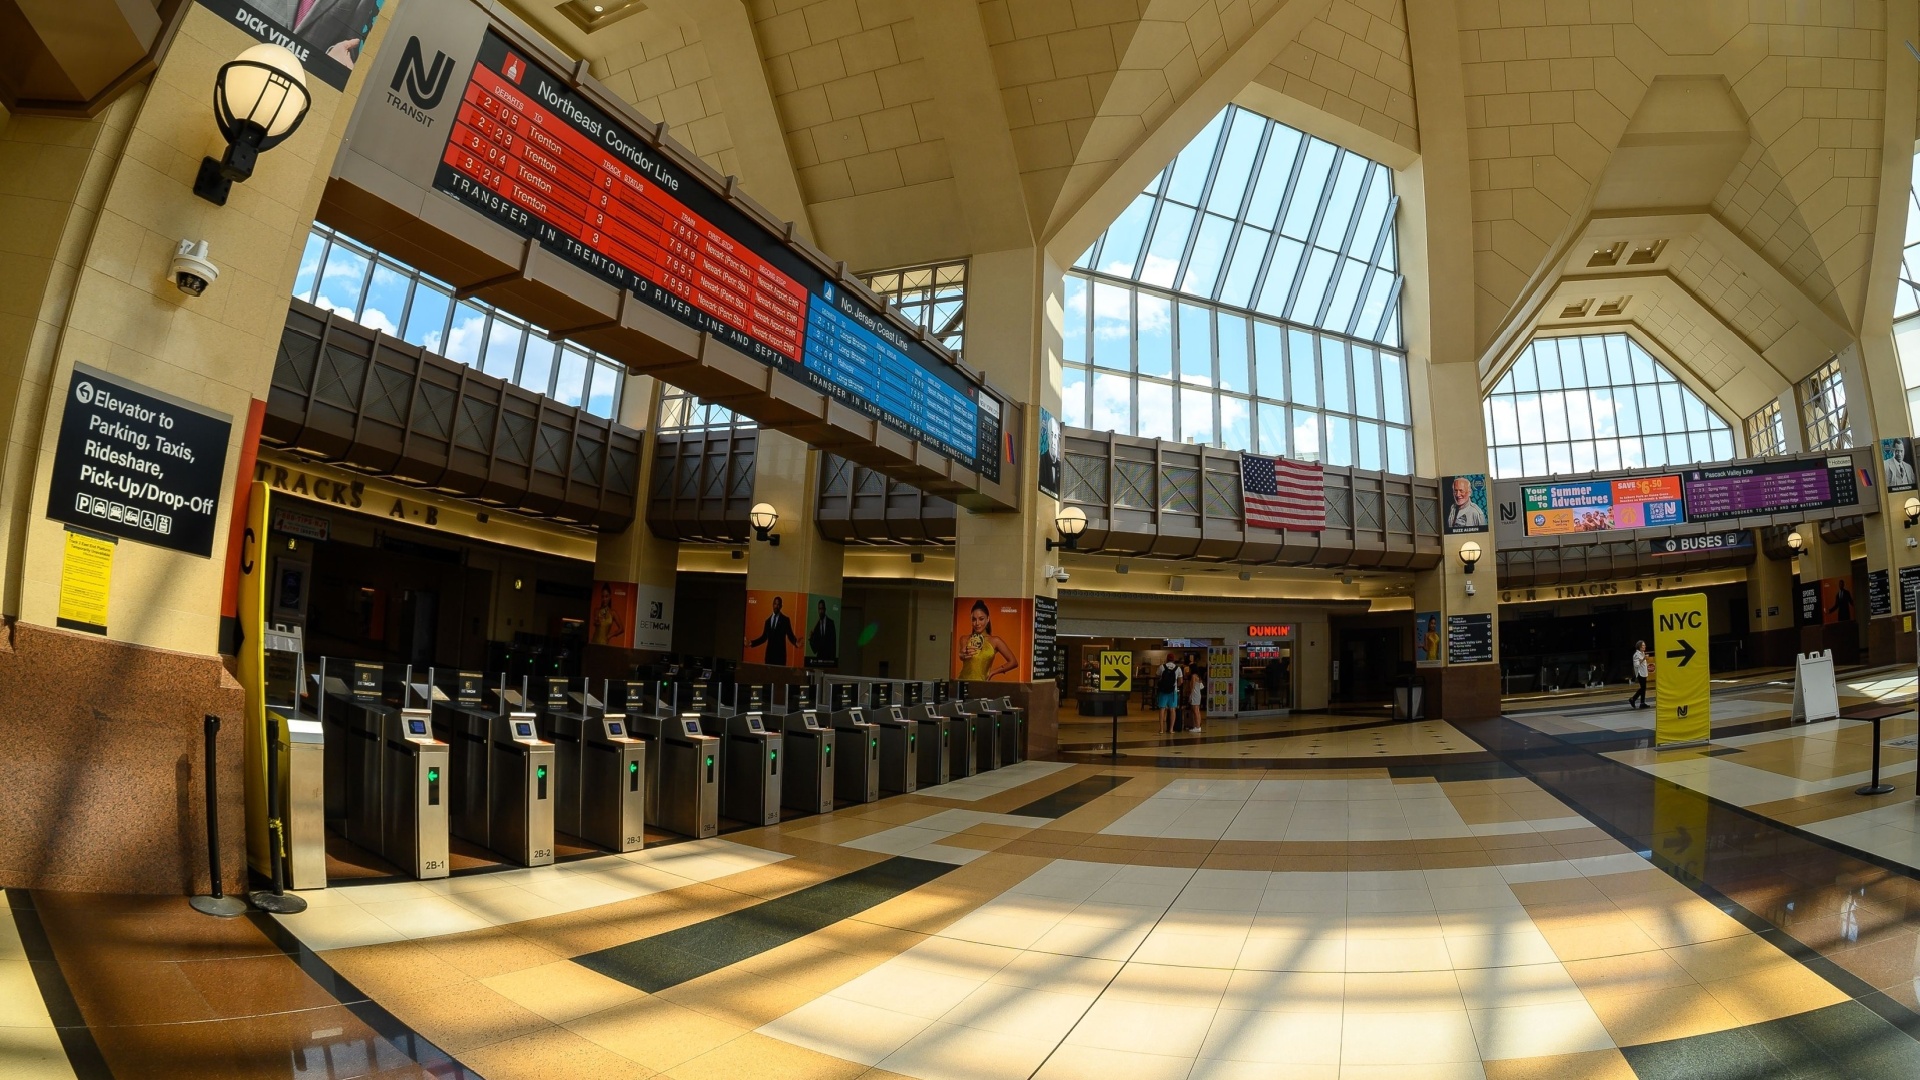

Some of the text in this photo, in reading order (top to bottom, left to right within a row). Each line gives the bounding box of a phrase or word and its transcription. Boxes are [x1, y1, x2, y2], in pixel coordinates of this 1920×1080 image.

[236, 8, 310, 62] DICK VITALE
[494, 86, 524, 111] DEPARTS
[386, 91, 434, 128] TRANSIT
[534, 112, 544, 124] TO
[538, 80, 680, 191] Northeast Corridor Line
[483, 98, 518, 126] 2:05
[530, 126, 562, 154] Trenton
[606, 177, 612, 186] 3
[674, 220, 698, 243] 7847
[706, 242, 724, 260] Newark
[602, 159, 644, 192] TRACK STATUS
[478, 116, 512, 145] 2:23
[524, 145, 556, 174] Trenton
[602, 196, 608, 205] 3
[670, 238, 696, 260] 7849
[703, 259, 722, 276] Newark
[472, 136, 506, 165] 3:04
[519, 164, 552, 193] Trenton
[597, 214, 603, 224] 3
[666, 256, 692, 278] 7851
[700, 276, 720, 292] Newark
[681, 212, 696, 227] TRAIN
[466, 158, 500, 186] 3:24
[513, 184, 546, 214] Trenton
[592, 232, 598, 243] 3
[664, 274, 690, 296] 7853
[698, 292, 717, 310] Newark
[452, 173, 784, 365] TRANSFER IN TRENTON TO RIVER LINE AND SEPTA
[841, 297, 908, 351] No. Jersey Coast Line
[94, 390, 174, 430] Elevator to
[808, 372, 846, 398] TRANSFER
[852, 396, 860, 404] IN
[864, 402, 880, 416] LONG
[884, 413, 906, 429] BRANCH
[89, 414, 195, 464] Parking, Taxis,
[84, 440, 164, 479] Rideshare,
[80, 465, 214, 515] Pick-Up/Drop-Off
[256, 462, 364, 508] TRACKS
[1551, 486, 1592, 498] Summer
[1618, 482, 1636, 490] SAVE
[1552, 494, 1608, 508] Adventures
[1681, 536, 1722, 550] BUSES
[1555, 582, 1618, 598] TRACKS
[640, 620, 670, 632] BETMGM
[1249, 625, 1290, 636] DUNKIN'
[1660, 610, 1702, 632] NYC
[1104, 654, 1130, 666] NYC
[1210, 654, 1232, 665] COLD
[1210, 666, 1232, 678] BEER
[1214, 680, 1226, 691] TO
[1214, 696, 1227, 706] GO
[704, 824, 716, 832] 2B-4
[626, 836, 641, 845] 2B-3
[534, 848, 550, 858] 2B-2
[426, 860, 444, 870] 2B-1
